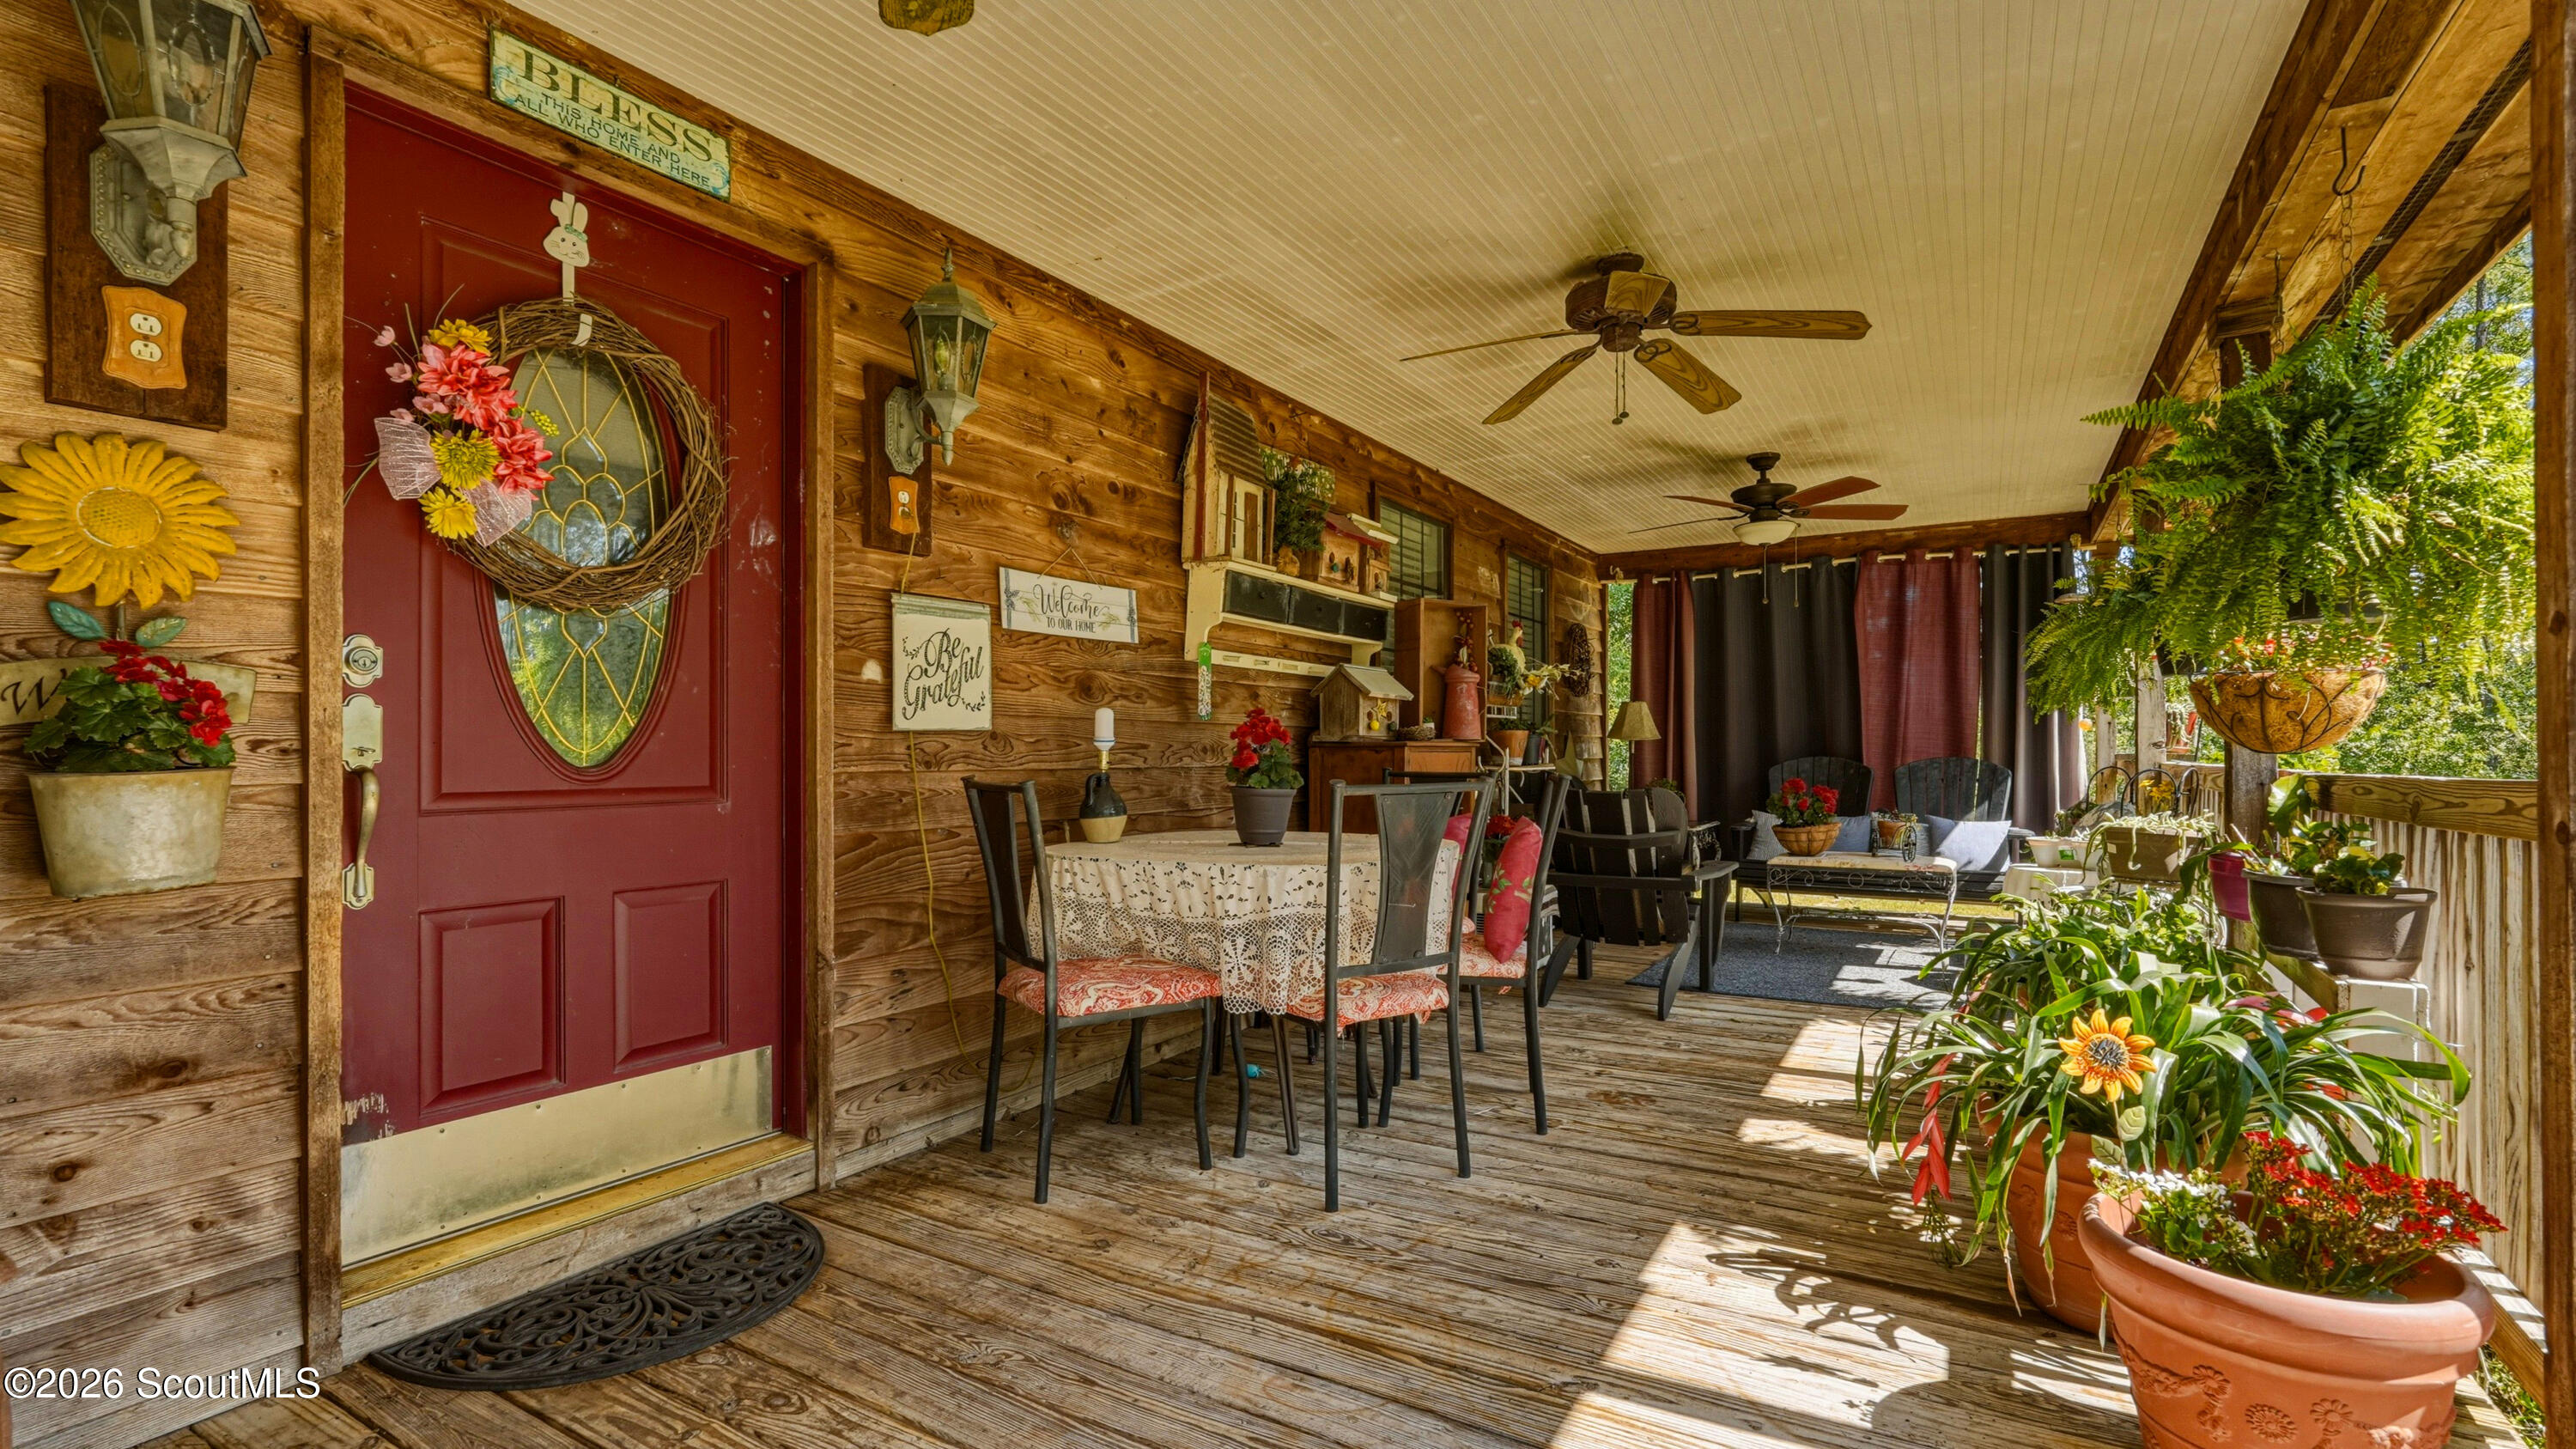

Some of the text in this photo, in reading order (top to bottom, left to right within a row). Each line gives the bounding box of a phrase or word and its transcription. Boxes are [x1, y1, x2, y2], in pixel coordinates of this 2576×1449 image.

[517, 49, 712, 161] BLESS
[514, 94, 711, 187] ALL WHO ENTER HERE
[591, 117, 640, 147] HOME
[647, 143, 681, 164] AND
[1033, 583, 1109, 619] Welcome
[1047, 616, 1097, 634] TO OUR HOME
[923, 628, 963, 678] Be
[902, 645, 983, 721] Grateful
